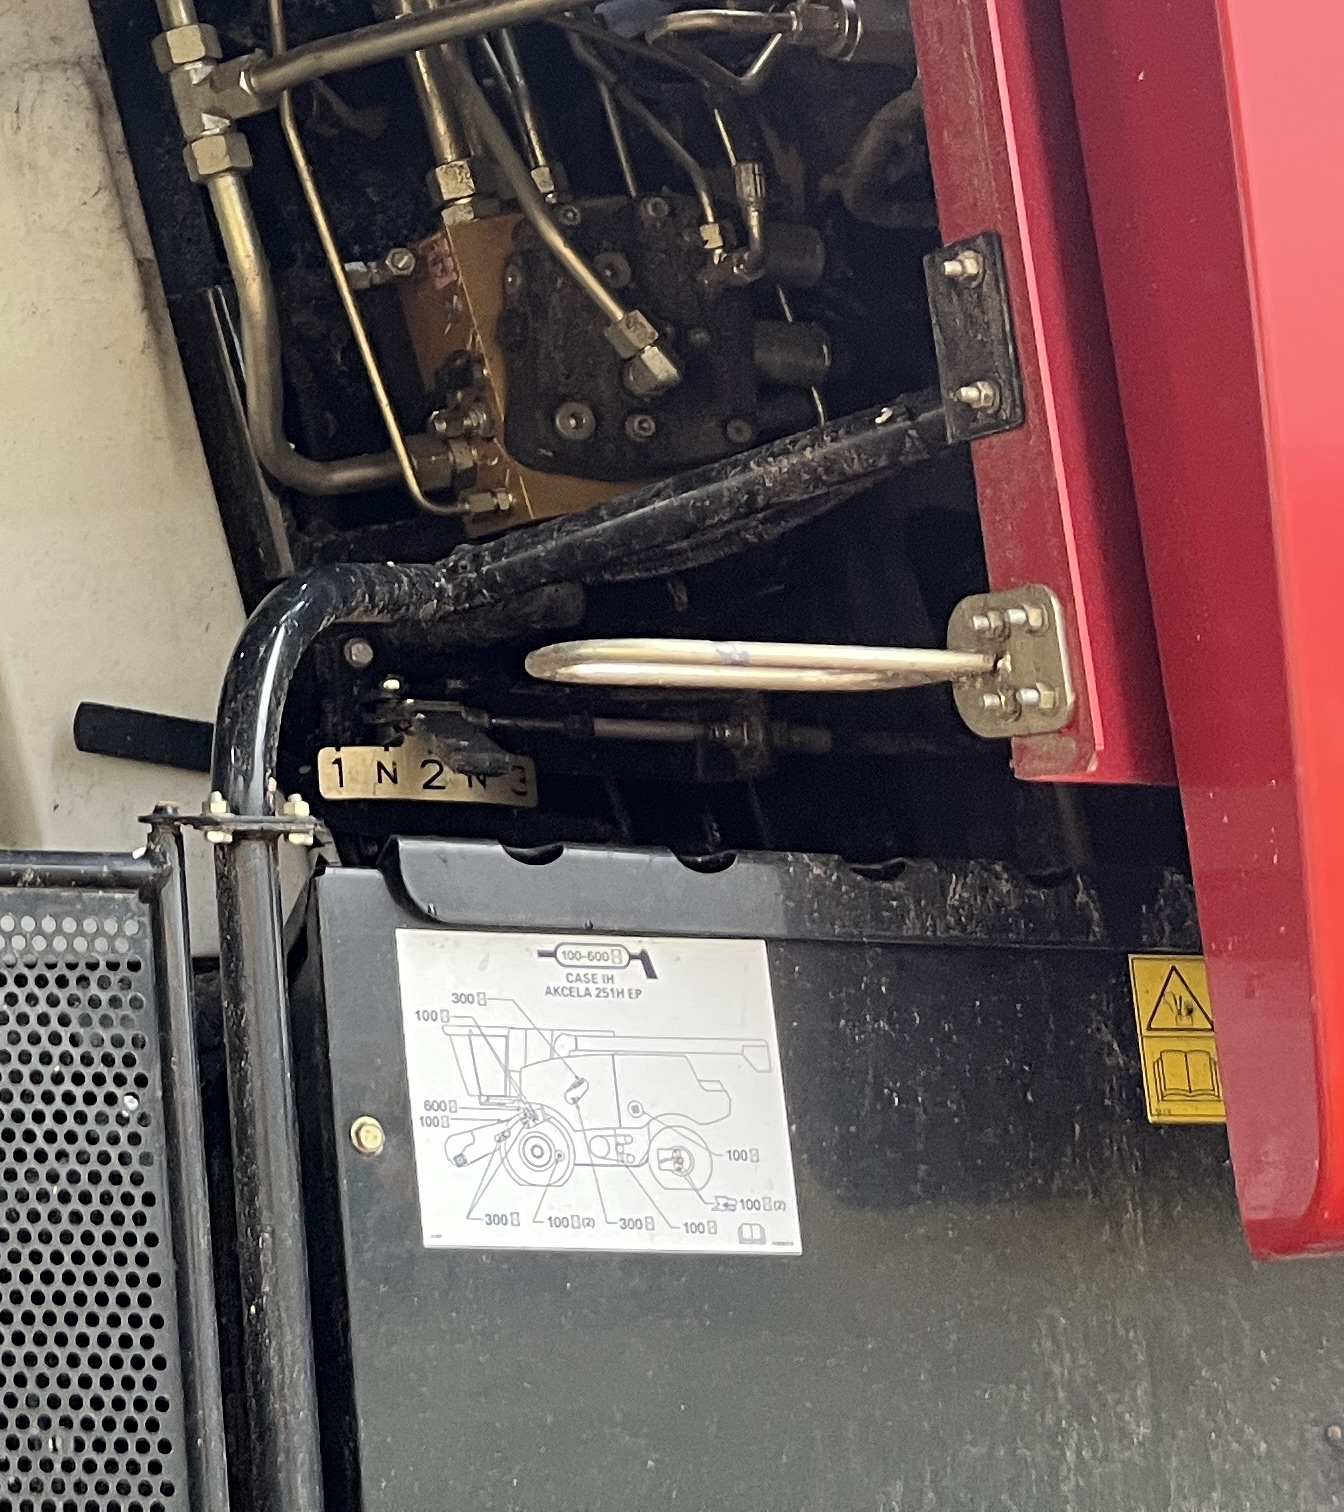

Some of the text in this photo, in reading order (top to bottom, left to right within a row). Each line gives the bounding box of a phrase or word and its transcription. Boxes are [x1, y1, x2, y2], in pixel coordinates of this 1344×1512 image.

[332, 757, 344, 788] 1
[377, 761, 398, 785] N
[420, 759, 446, 790] 2
[561, 950, 610, 962] 100-600
[565, 972, 615, 985] CASE IH
[451, 992, 475, 1004] 300
[544, 986, 643, 1000] AKCELA 251H EP
[415, 1009, 438, 1022] 100
[423, 1100, 447, 1112] 600
[419, 1115, 440, 1127] 100
[726, 1149, 748, 1162] 100
[739, 1199, 761, 1211] 100
[484, 1213, 508, 1226] 300
[547, 1216, 569, 1228] 100
[619, 1218, 643, 1230] 300
[683, 1222, 705, 1234] 100
